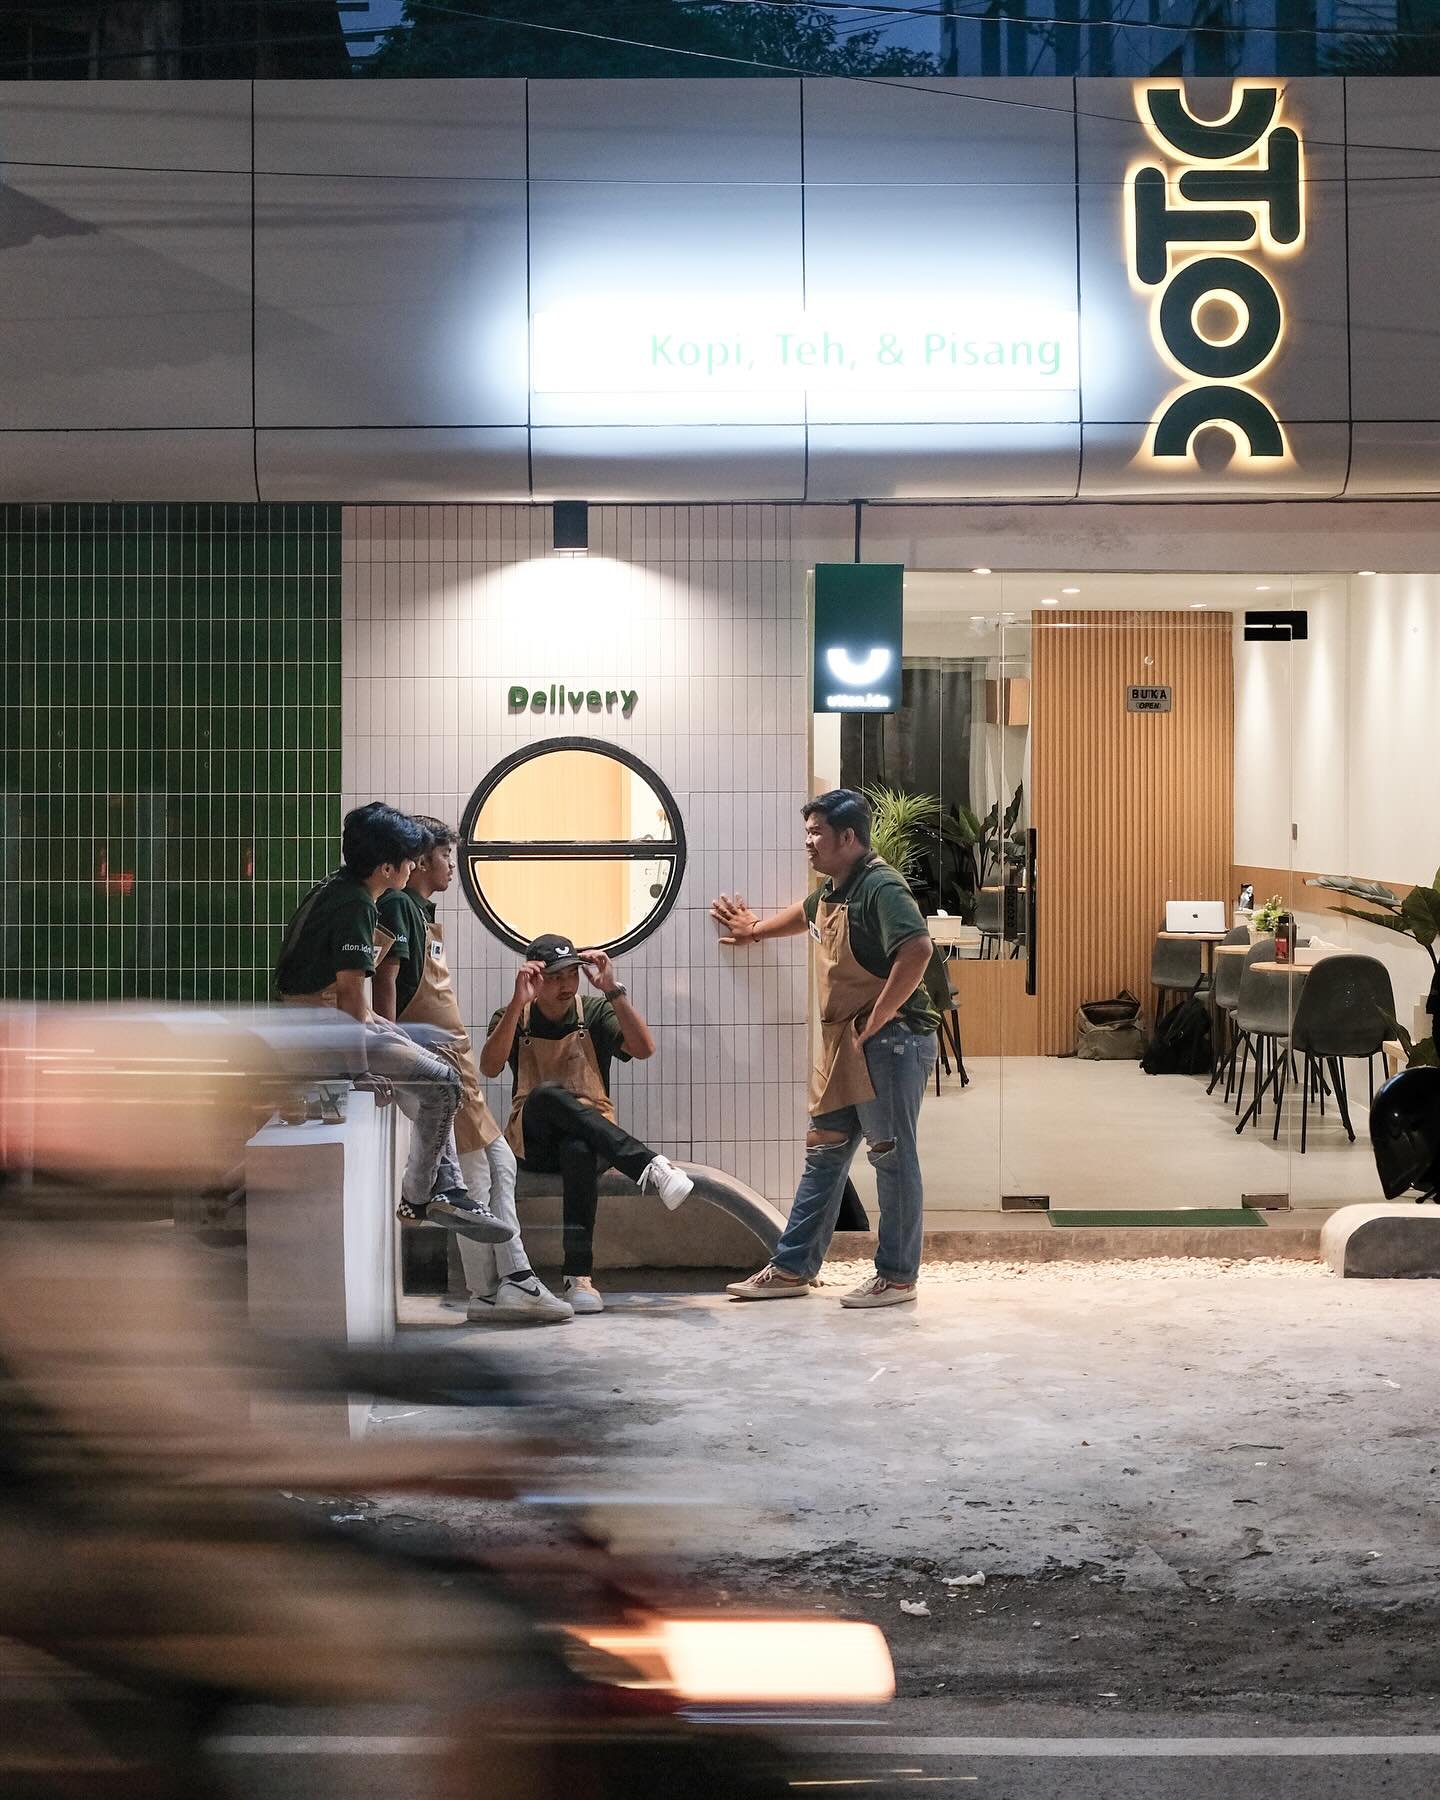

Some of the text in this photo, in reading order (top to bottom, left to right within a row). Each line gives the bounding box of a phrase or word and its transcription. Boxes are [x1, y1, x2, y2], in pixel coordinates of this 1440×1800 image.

[651, 332, 1061, 375] Kopi, Teh, & Pisang
[508, 684, 638, 714] Delivery
[1132, 689, 1167, 699] BUKA
